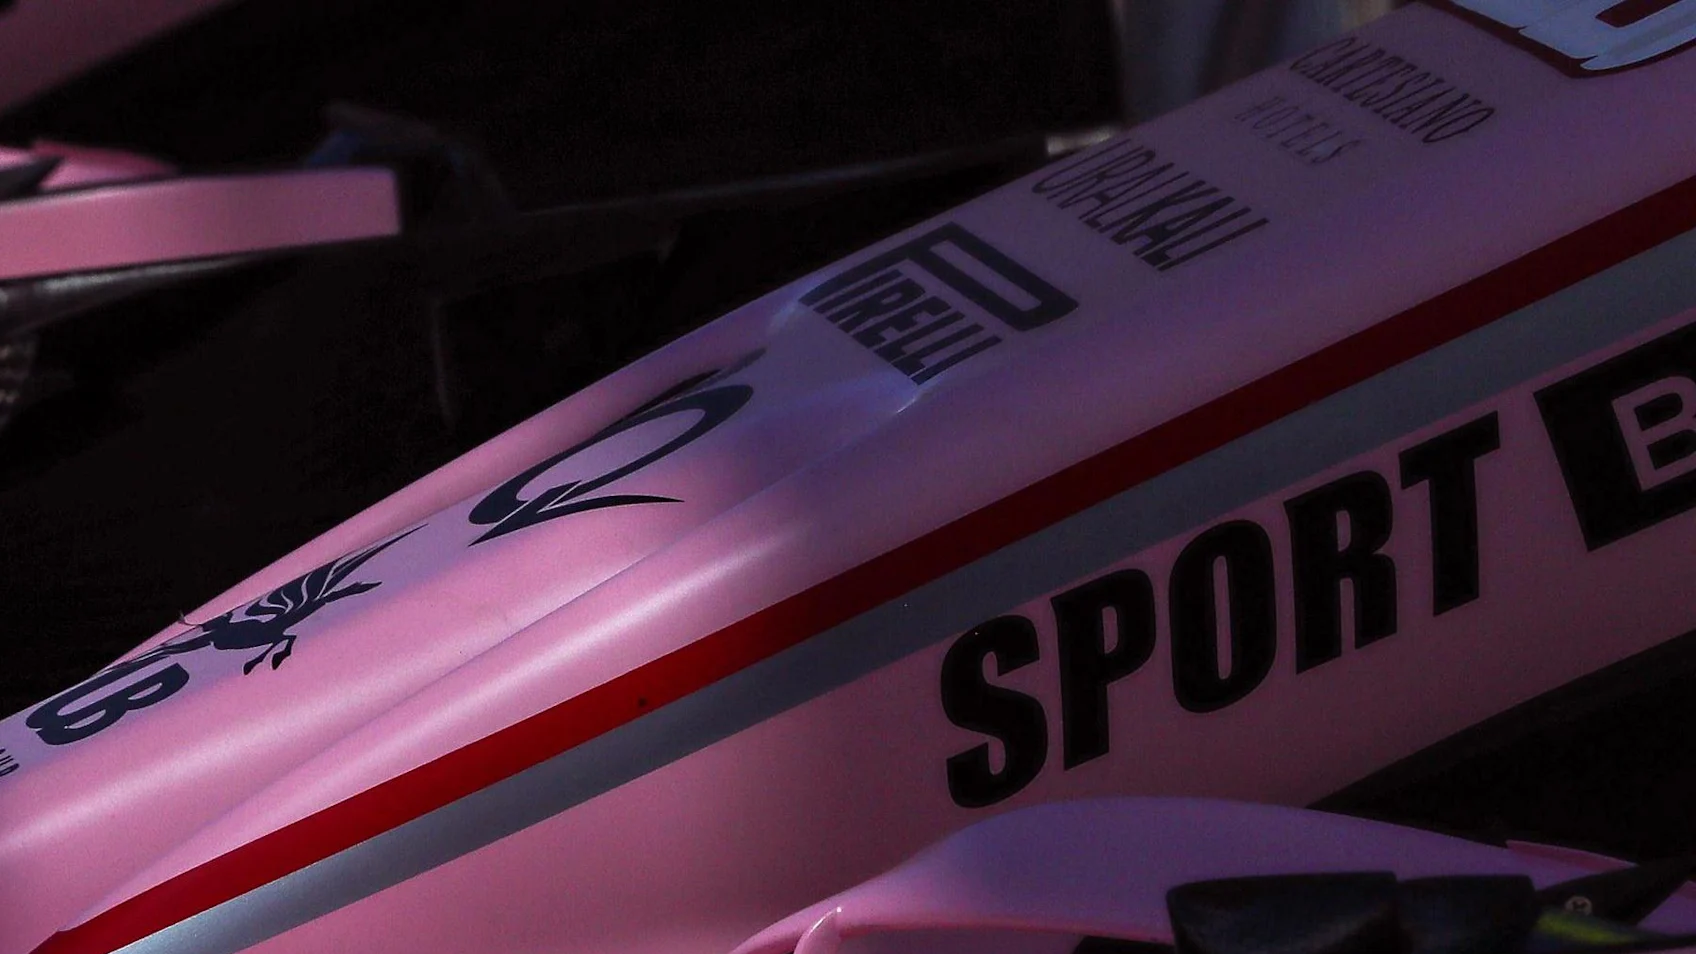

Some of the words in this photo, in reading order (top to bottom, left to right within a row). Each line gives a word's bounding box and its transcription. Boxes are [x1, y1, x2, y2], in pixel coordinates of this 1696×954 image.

[1234, 95, 1362, 166] HOTELS
[1289, 36, 1497, 144] CARTESIANO
[1031, 138, 1270, 272] URALKALI
[797, 221, 1079, 386] PIRELLI
[940, 411, 1500, 809] SPORT
